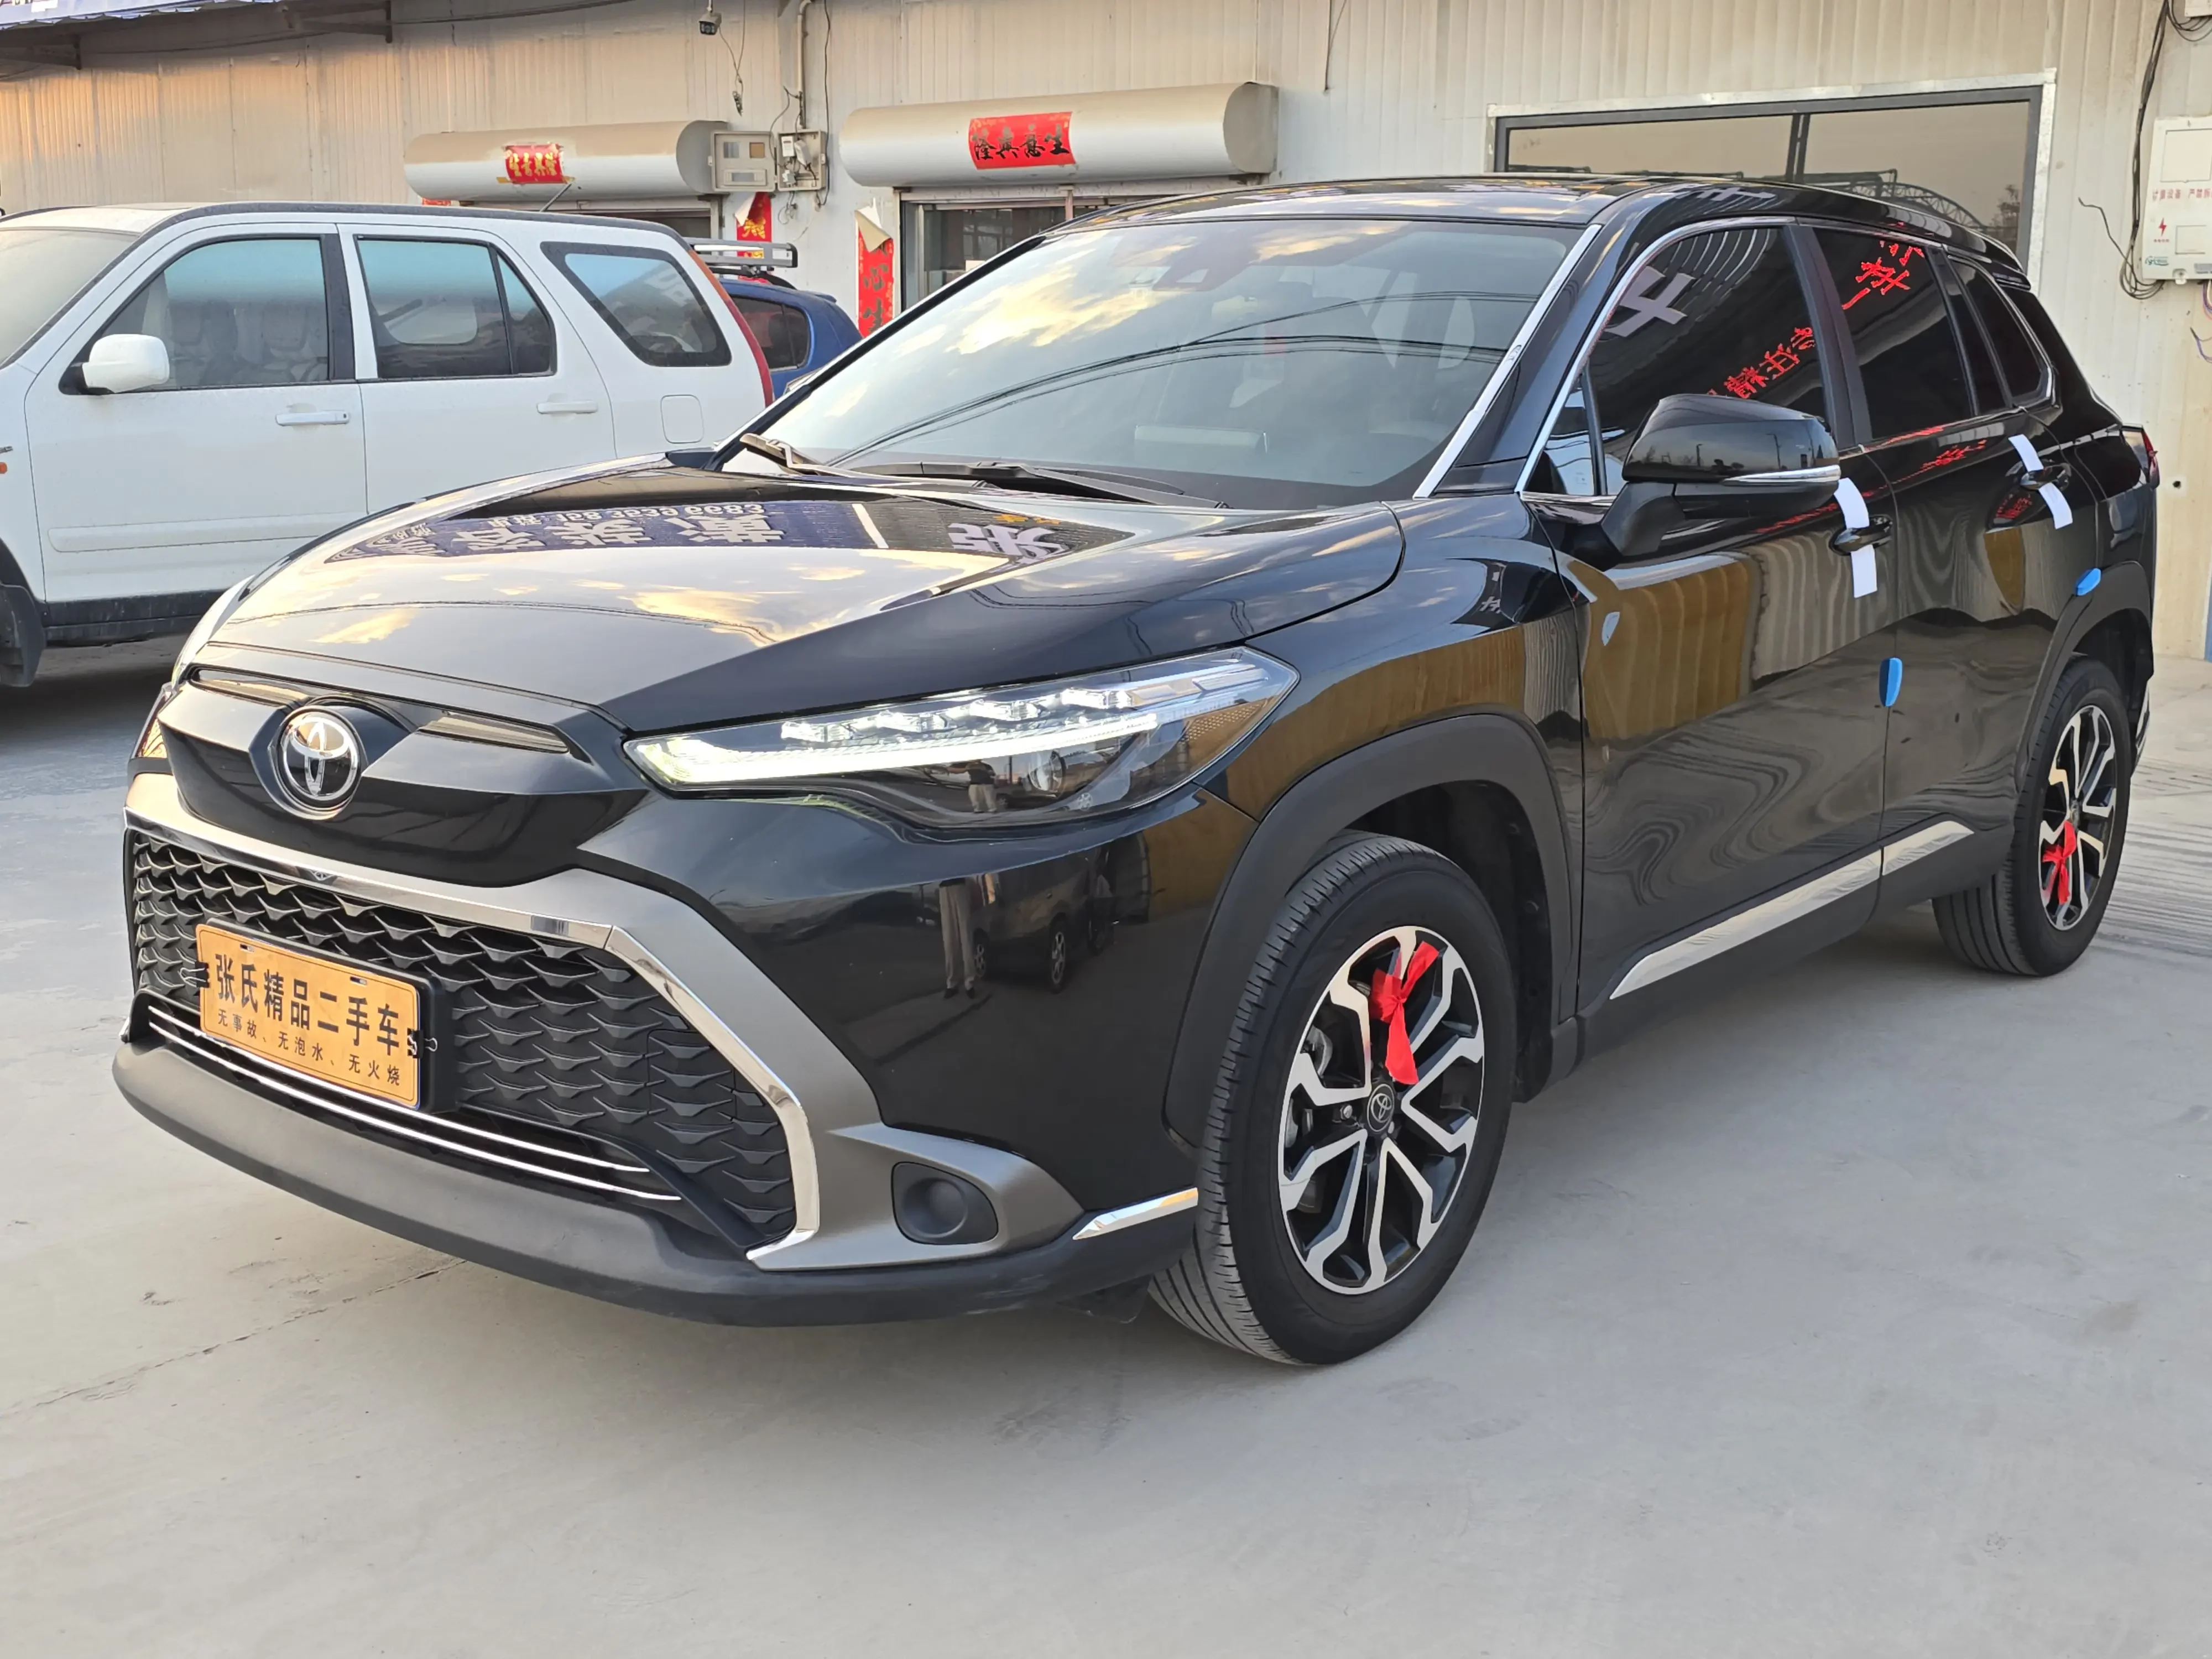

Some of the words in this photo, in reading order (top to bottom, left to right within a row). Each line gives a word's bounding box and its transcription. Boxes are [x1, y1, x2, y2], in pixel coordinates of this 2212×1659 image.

[214, 953, 400, 1056] 张氏精品二手车
[218, 1008, 400, 1086] 无事故、无泡水、无火烧
